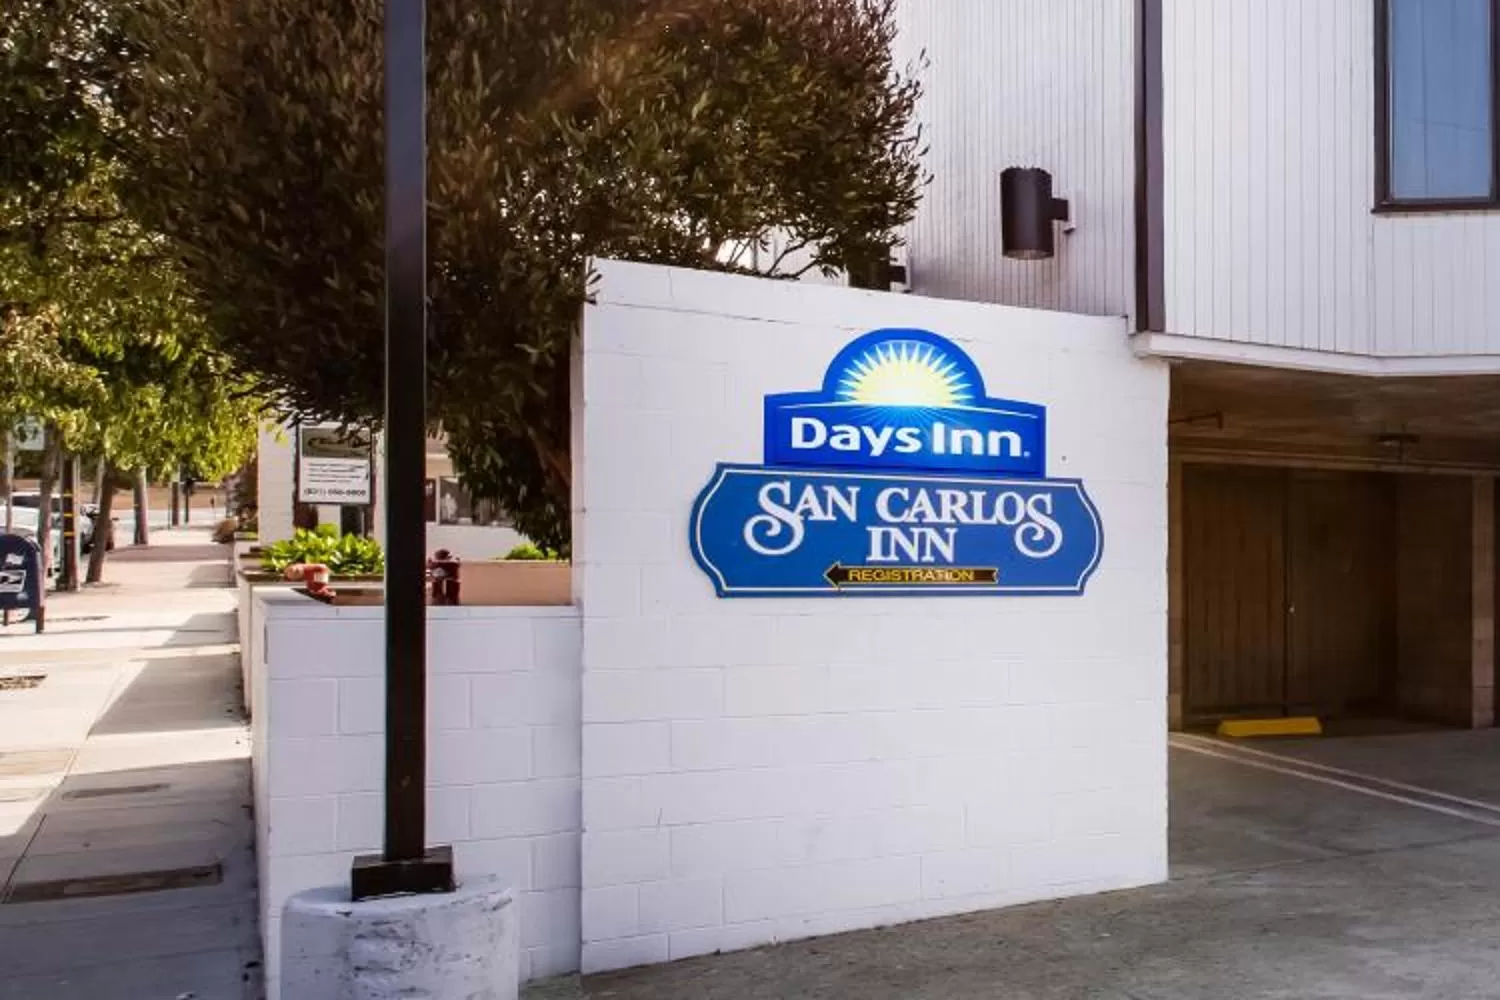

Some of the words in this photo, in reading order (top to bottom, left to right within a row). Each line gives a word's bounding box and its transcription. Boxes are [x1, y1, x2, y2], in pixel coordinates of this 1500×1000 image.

[790, 417, 921, 456] Days
[932, 422, 1022, 457] Inn
[743, 480, 861, 556] SAN
[875, 487, 1064, 559] CARLOS
[865, 526, 958, 563] INN
[847, 568, 976, 583] REGISTRATION
